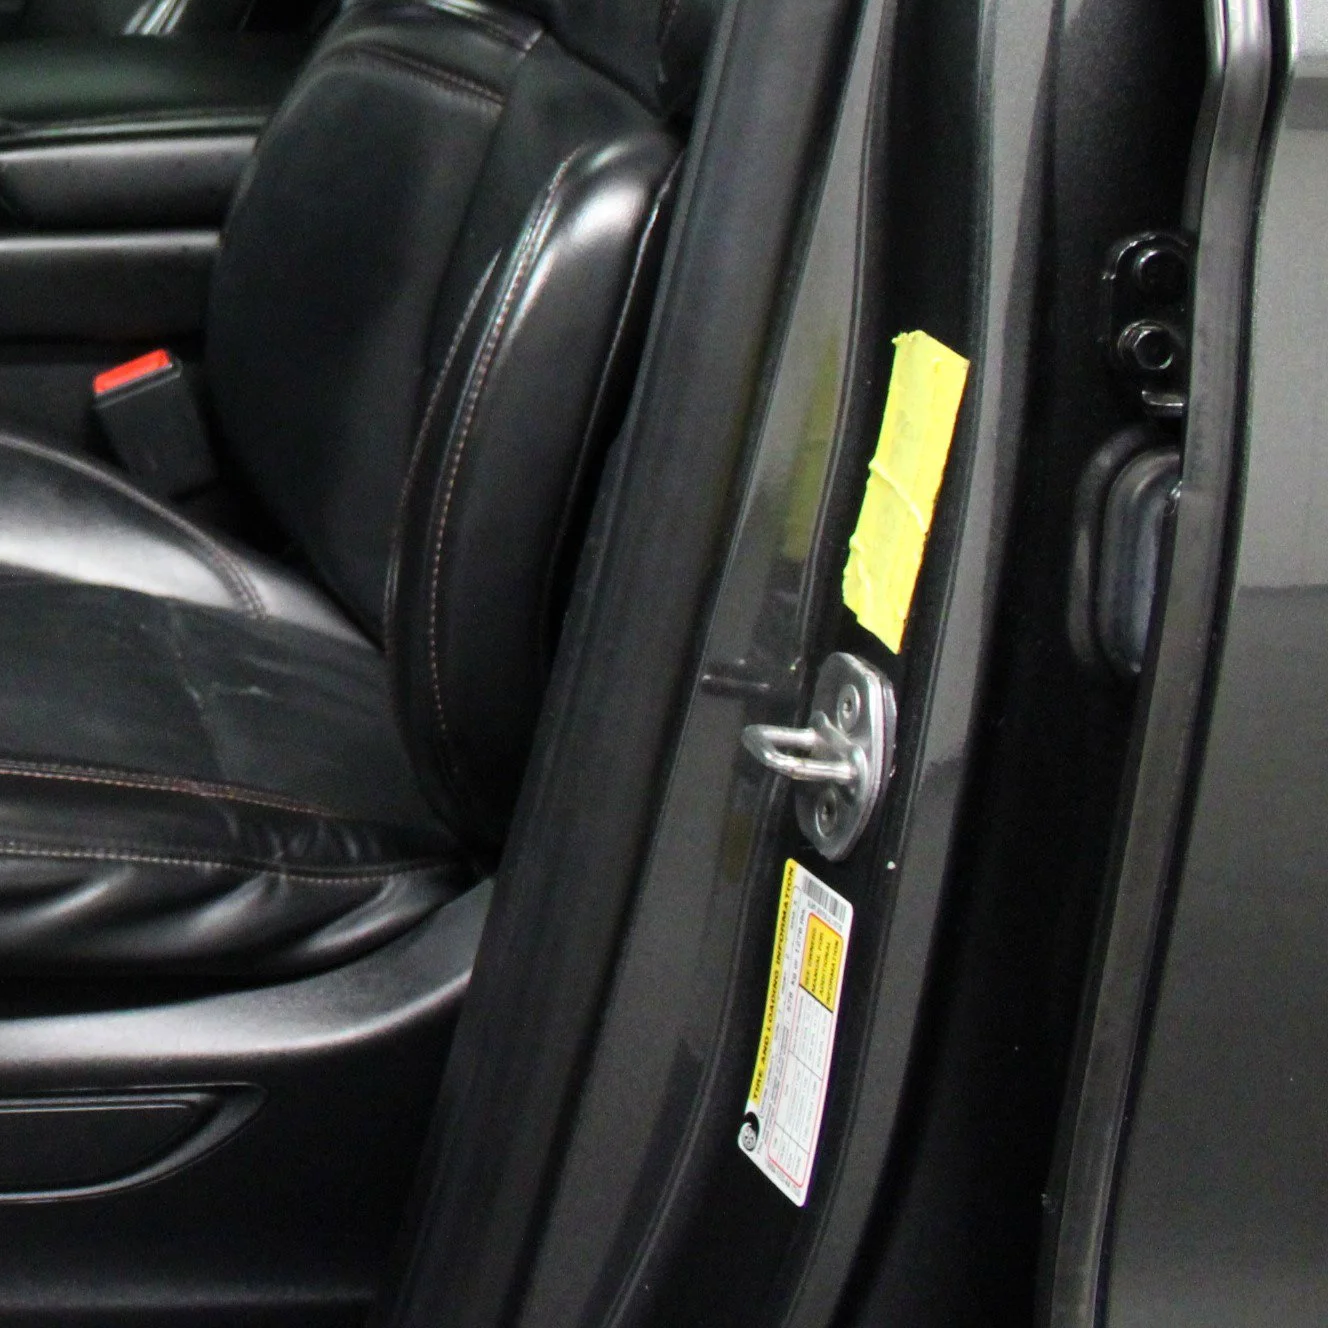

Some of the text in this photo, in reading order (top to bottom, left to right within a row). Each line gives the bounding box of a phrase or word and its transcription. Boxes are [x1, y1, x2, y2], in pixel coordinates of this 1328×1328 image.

[752, 1070, 764, 1100] TIRE
[761, 1035, 771, 1064] AND
[766, 970, 779, 1031] LOADING
[776, 866, 794, 965] INFORMATION
